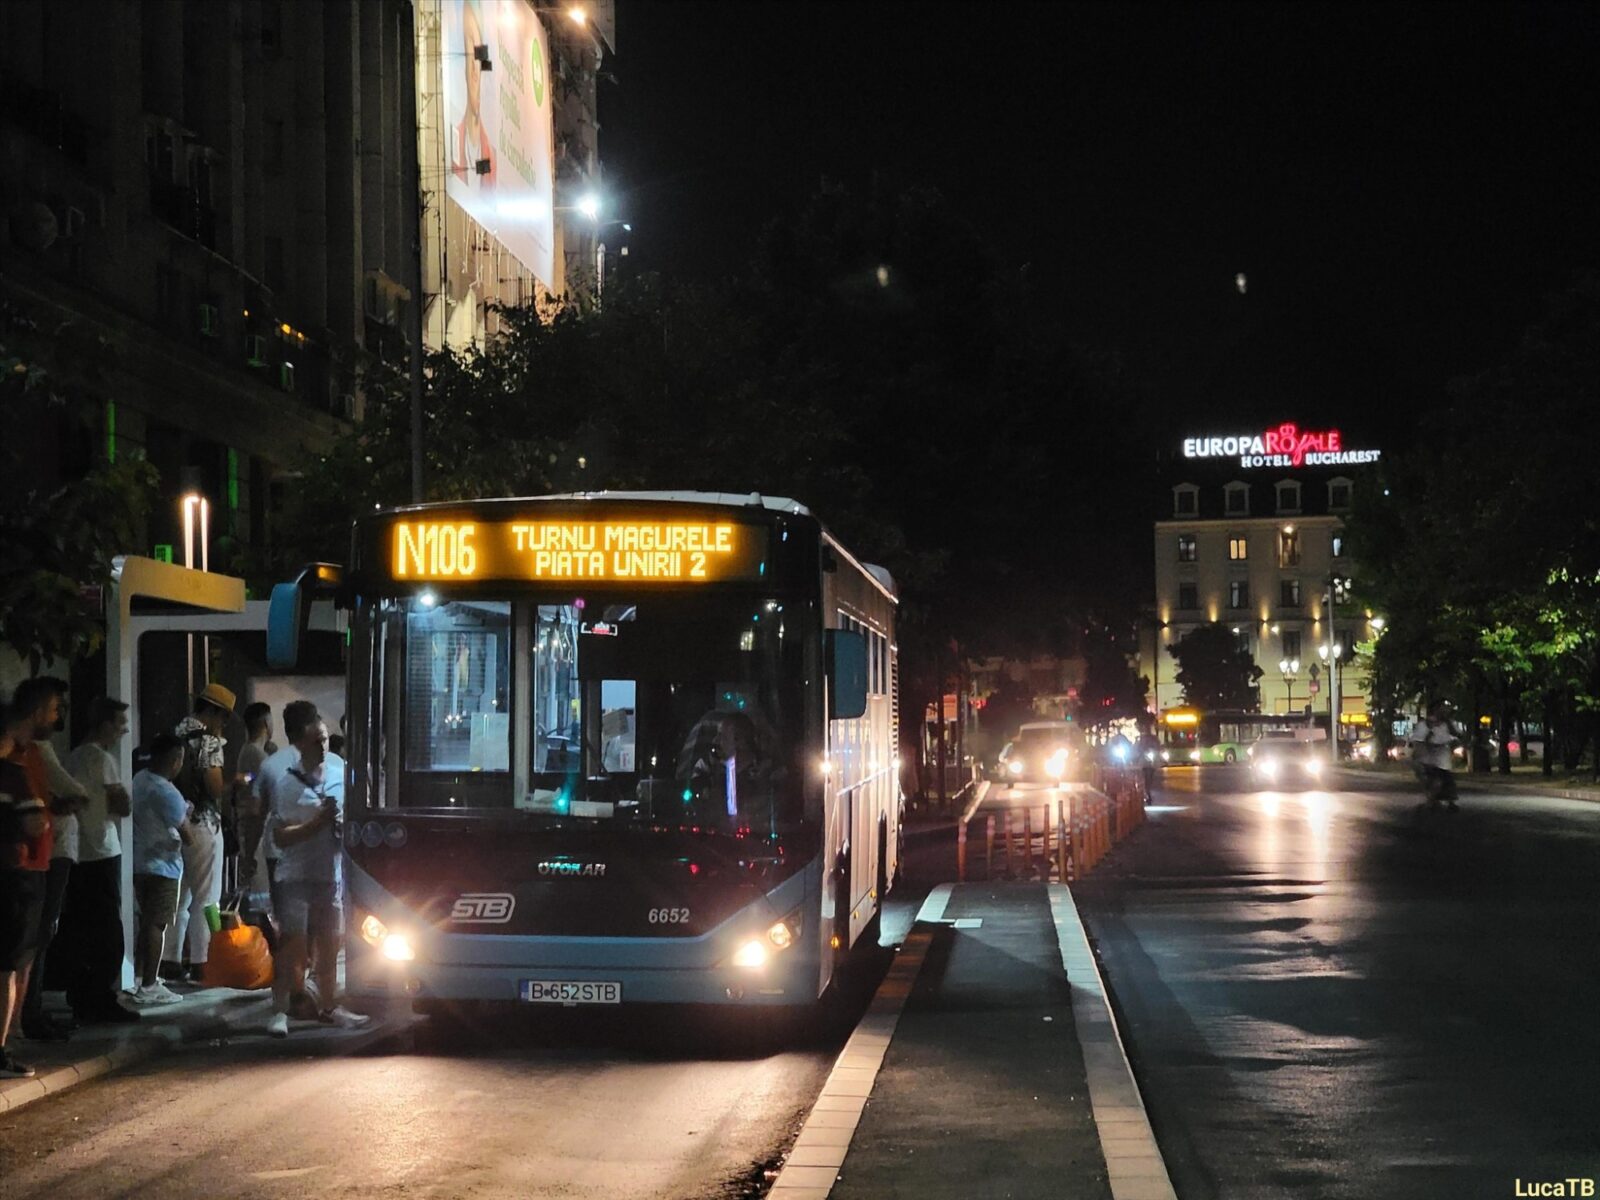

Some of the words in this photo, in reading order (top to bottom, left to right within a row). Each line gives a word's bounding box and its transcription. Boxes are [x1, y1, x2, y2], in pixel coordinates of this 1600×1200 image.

[1184, 435, 1264, 457] EUROPA
[1241, 454, 1291, 468] HOTEL
[1304, 450, 1380, 466] BUCHAREST
[397, 524, 477, 576] N106
[511, 526, 596, 552] TURNU
[604, 526, 732, 552] MAGURELE
[535, 551, 605, 577] PIATA
[613, 551, 681, 577] UNIRII
[690, 552, 706, 577] 2
[451, 898, 509, 918] STB
[648, 907, 690, 924] 6652
